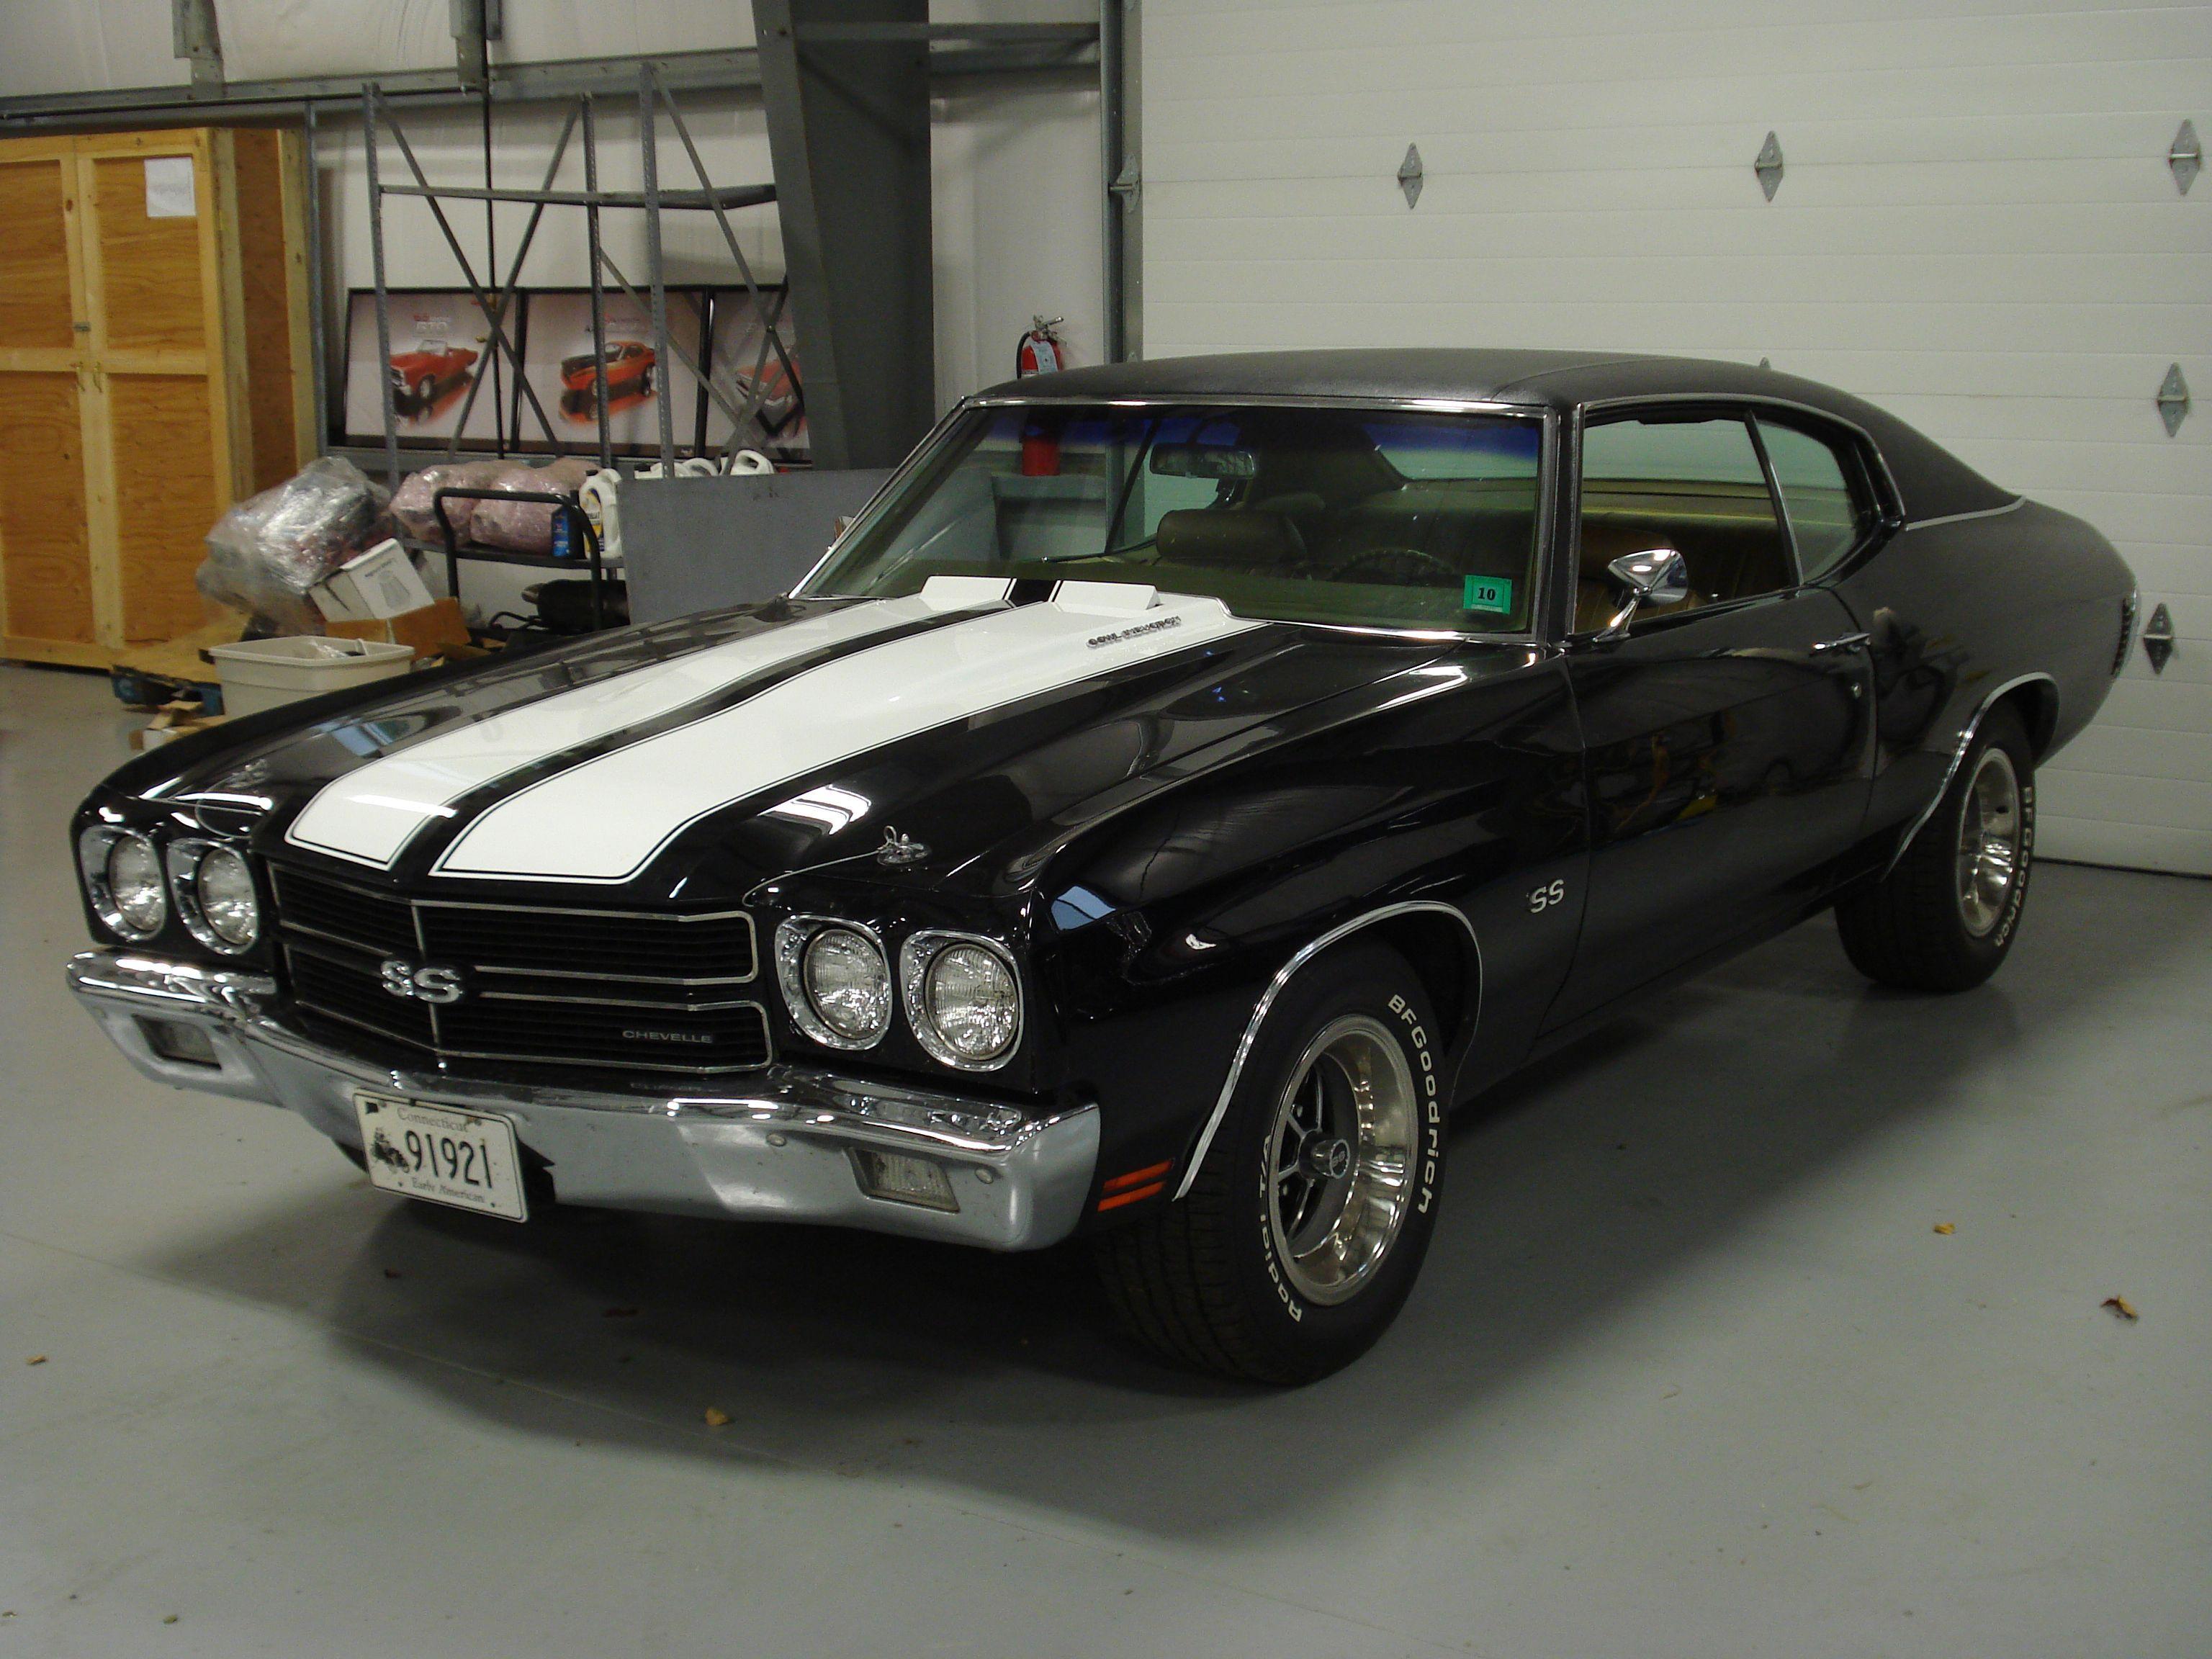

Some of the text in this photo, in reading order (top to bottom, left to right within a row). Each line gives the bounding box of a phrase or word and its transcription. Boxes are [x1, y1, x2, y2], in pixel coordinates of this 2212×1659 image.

[1478, 588, 1496, 601] 10
[1530, 879, 1564, 913] SS
[379, 960, 462, 1004] SS
[622, 1030, 713, 1043] CHEVELLE
[1388, 994, 1440, 1214] BFGoodrich
[405, 1130, 492, 1189] 91921
